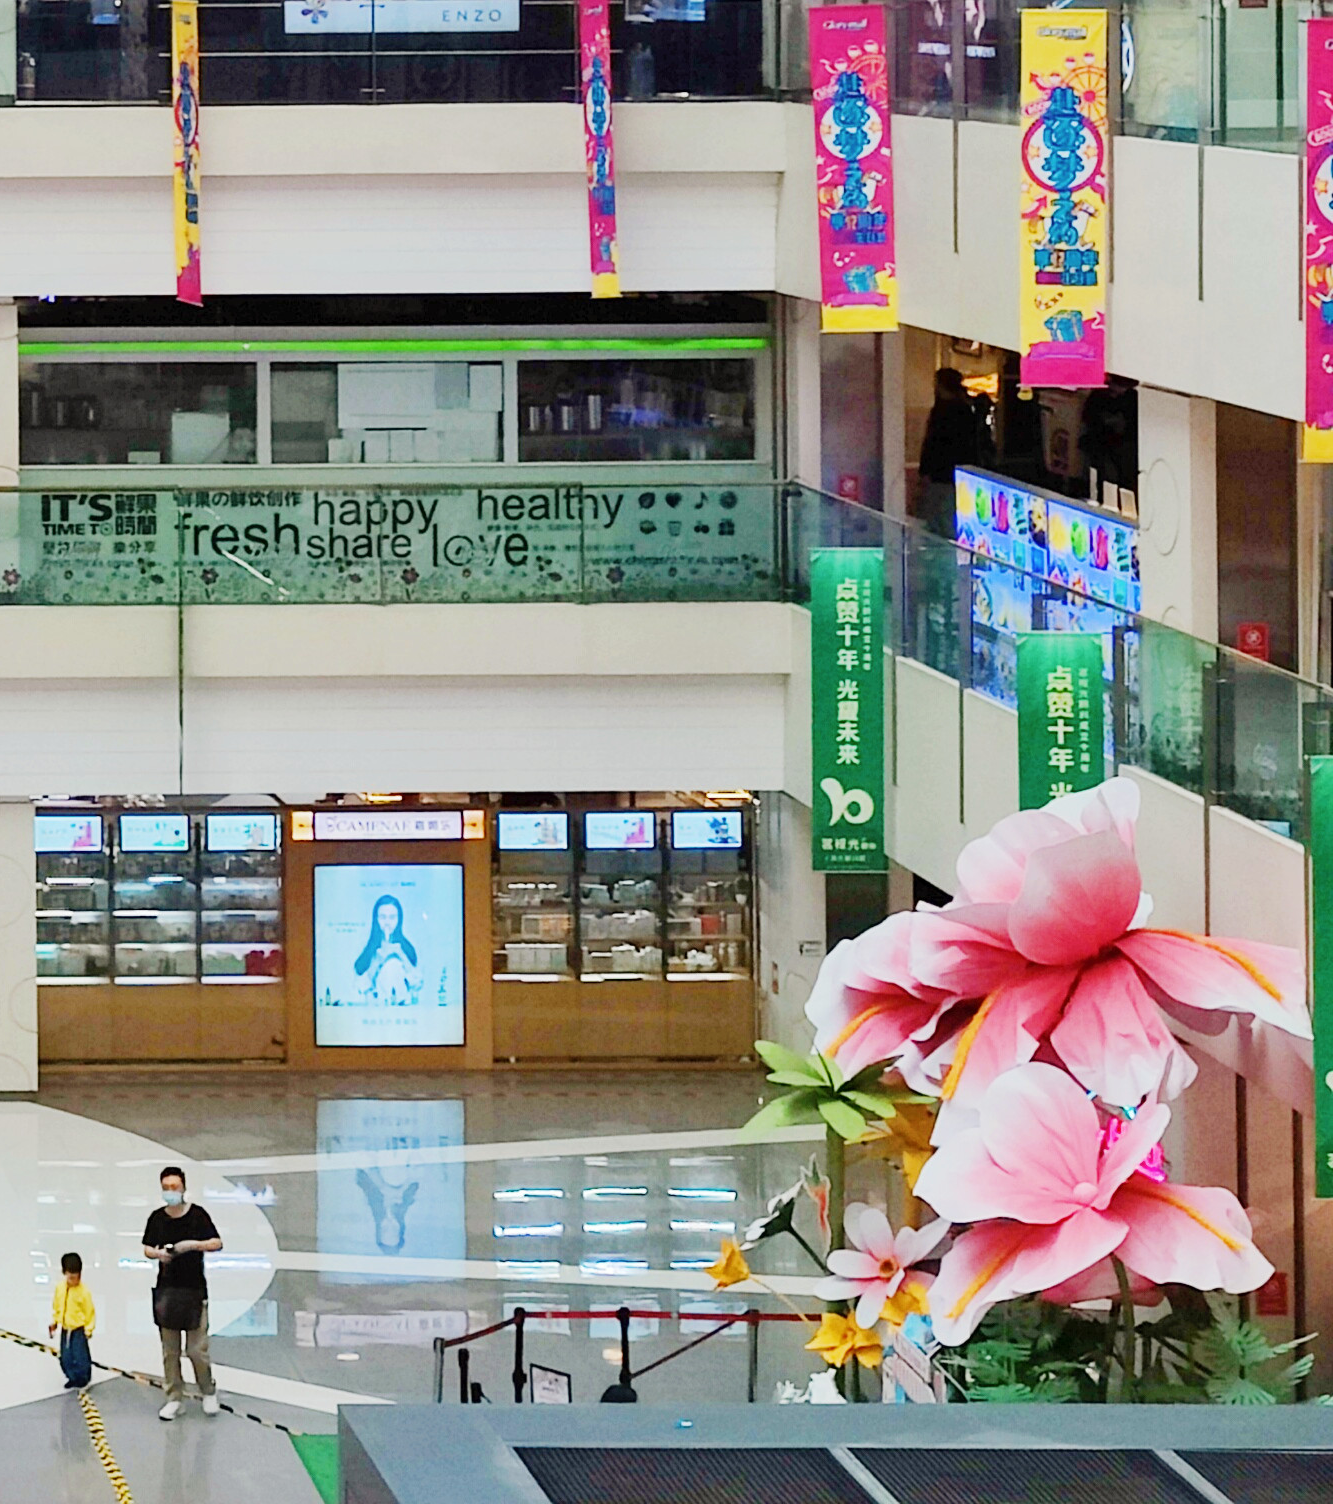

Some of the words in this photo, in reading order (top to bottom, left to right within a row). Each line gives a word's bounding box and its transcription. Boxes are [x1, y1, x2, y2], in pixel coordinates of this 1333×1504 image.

[442, 7, 505, 23] ENZO
[41, 494, 113, 522] IT'S
[115, 515, 157, 536] 時間
[314, 492, 438, 534] happy
[476, 489, 623, 528] healthy
[42, 523, 85, 536] TIME
[174, 513, 300, 556] fresh
[306, 525, 412, 558] share
[835, 578, 860, 672] 点赞十年
[1046, 666, 1074, 773] 点赞十年
